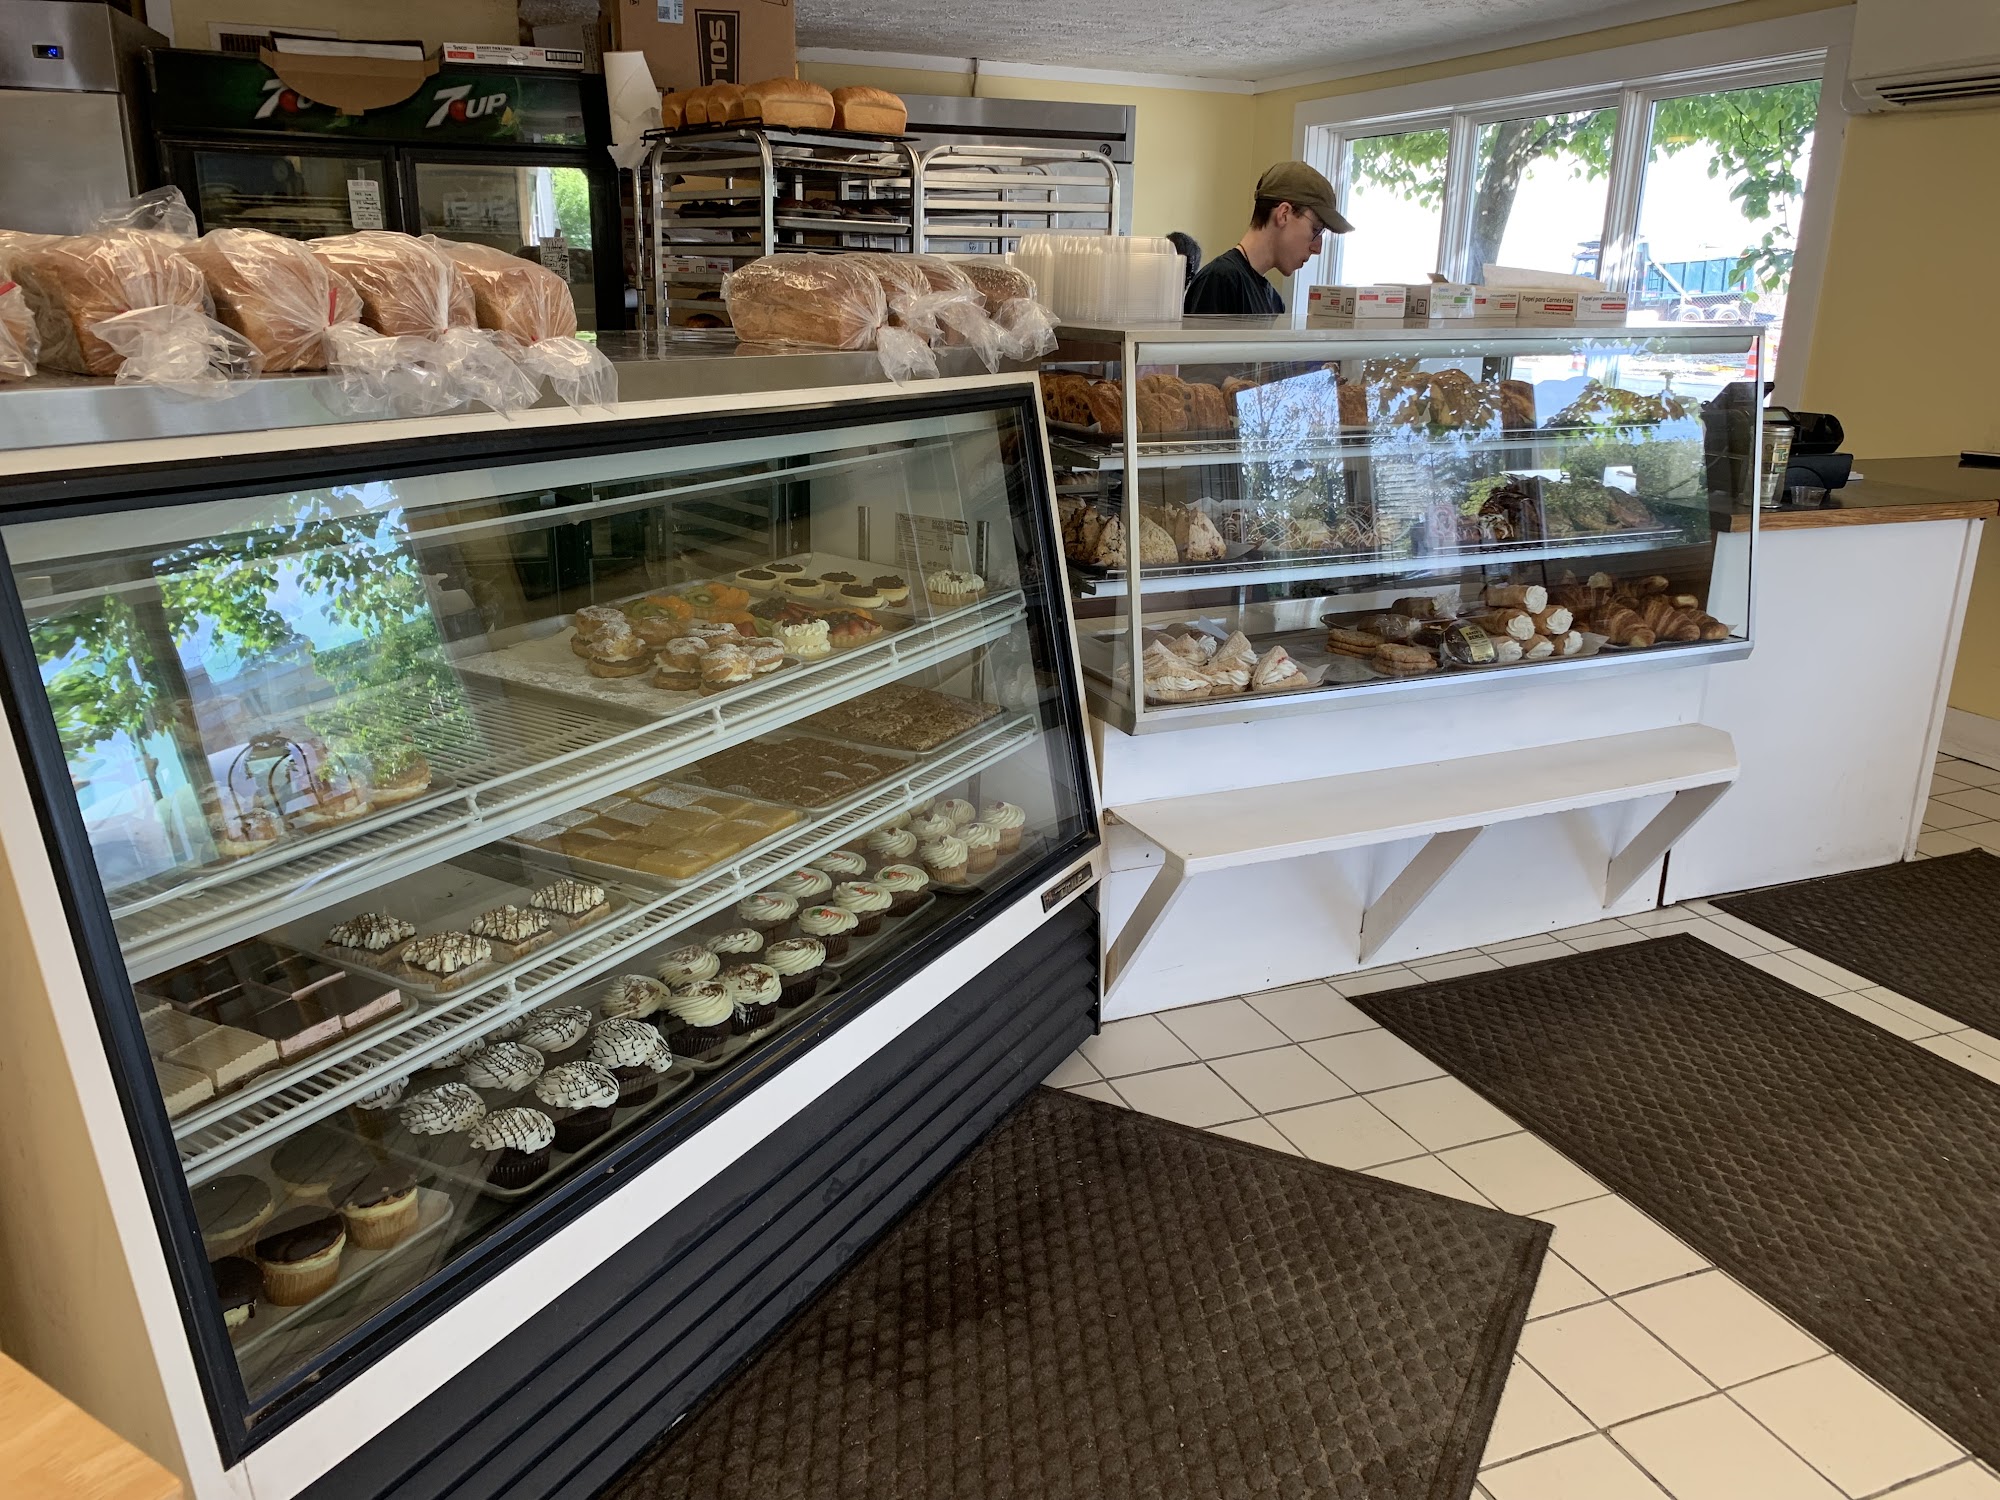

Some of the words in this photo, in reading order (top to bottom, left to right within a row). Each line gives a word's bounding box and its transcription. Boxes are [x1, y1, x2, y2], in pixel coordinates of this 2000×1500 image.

[709, 20, 728, 87] SOL
[425, 84, 507, 128] 7UP
[1522, 295, 1535, 303] Papel
